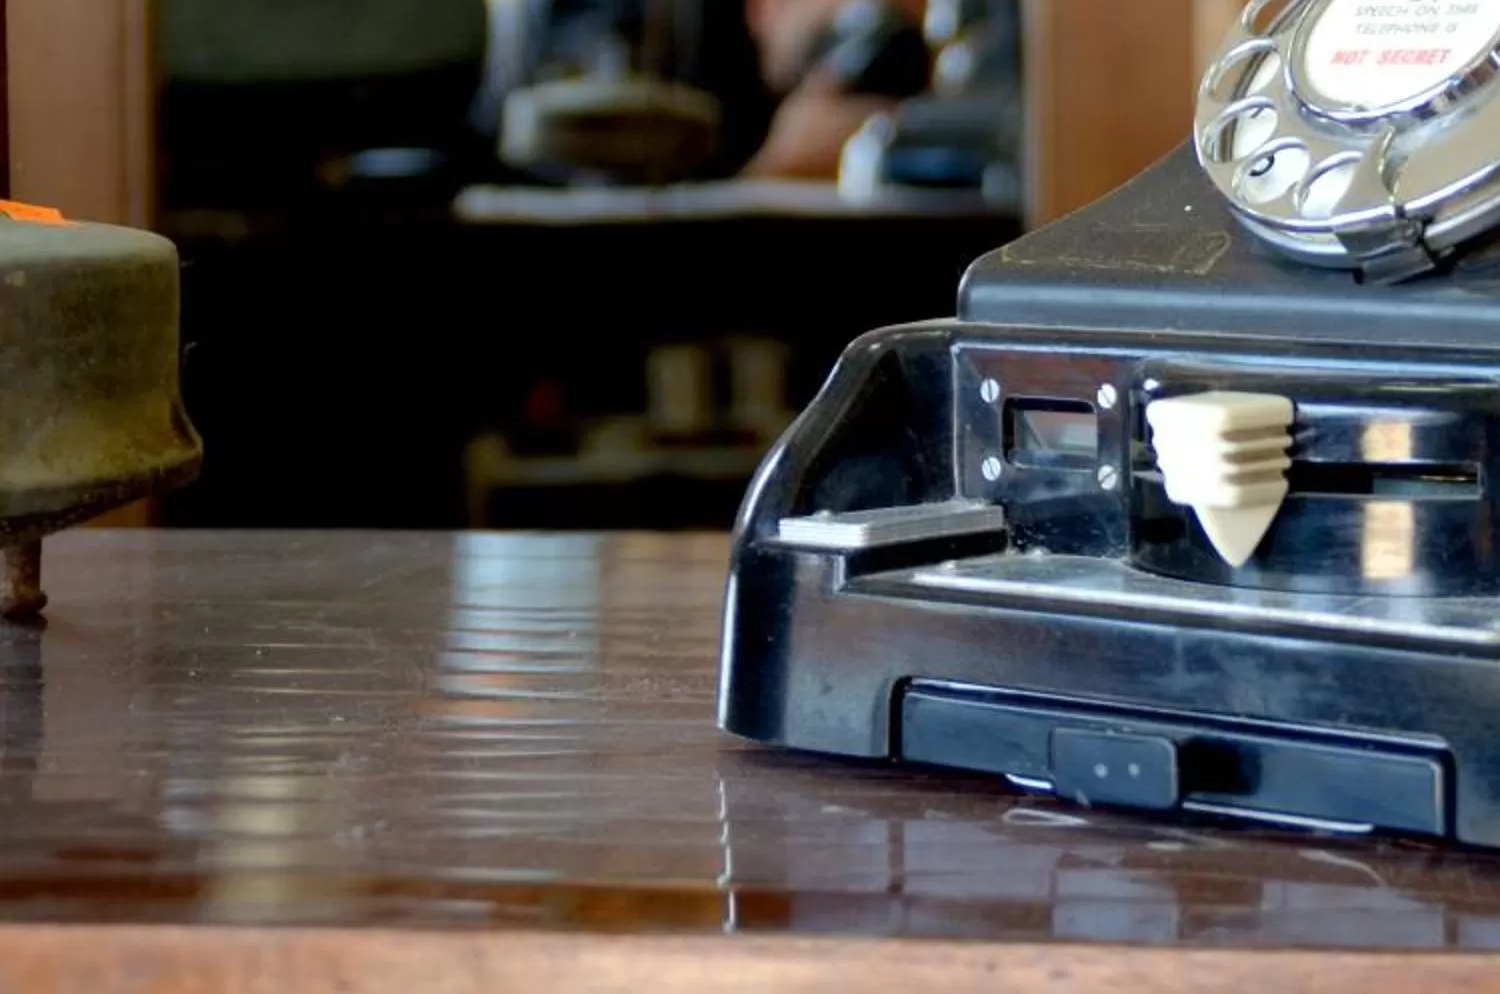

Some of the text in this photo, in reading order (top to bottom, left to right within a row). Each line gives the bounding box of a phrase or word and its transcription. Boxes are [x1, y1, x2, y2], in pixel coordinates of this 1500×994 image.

[1354, 2, 1480, 17] SPEECH ON THIS
[1355, 22, 1441, 35] TELEPHONE
[1328, 48, 1452, 66] NOT SECRET
